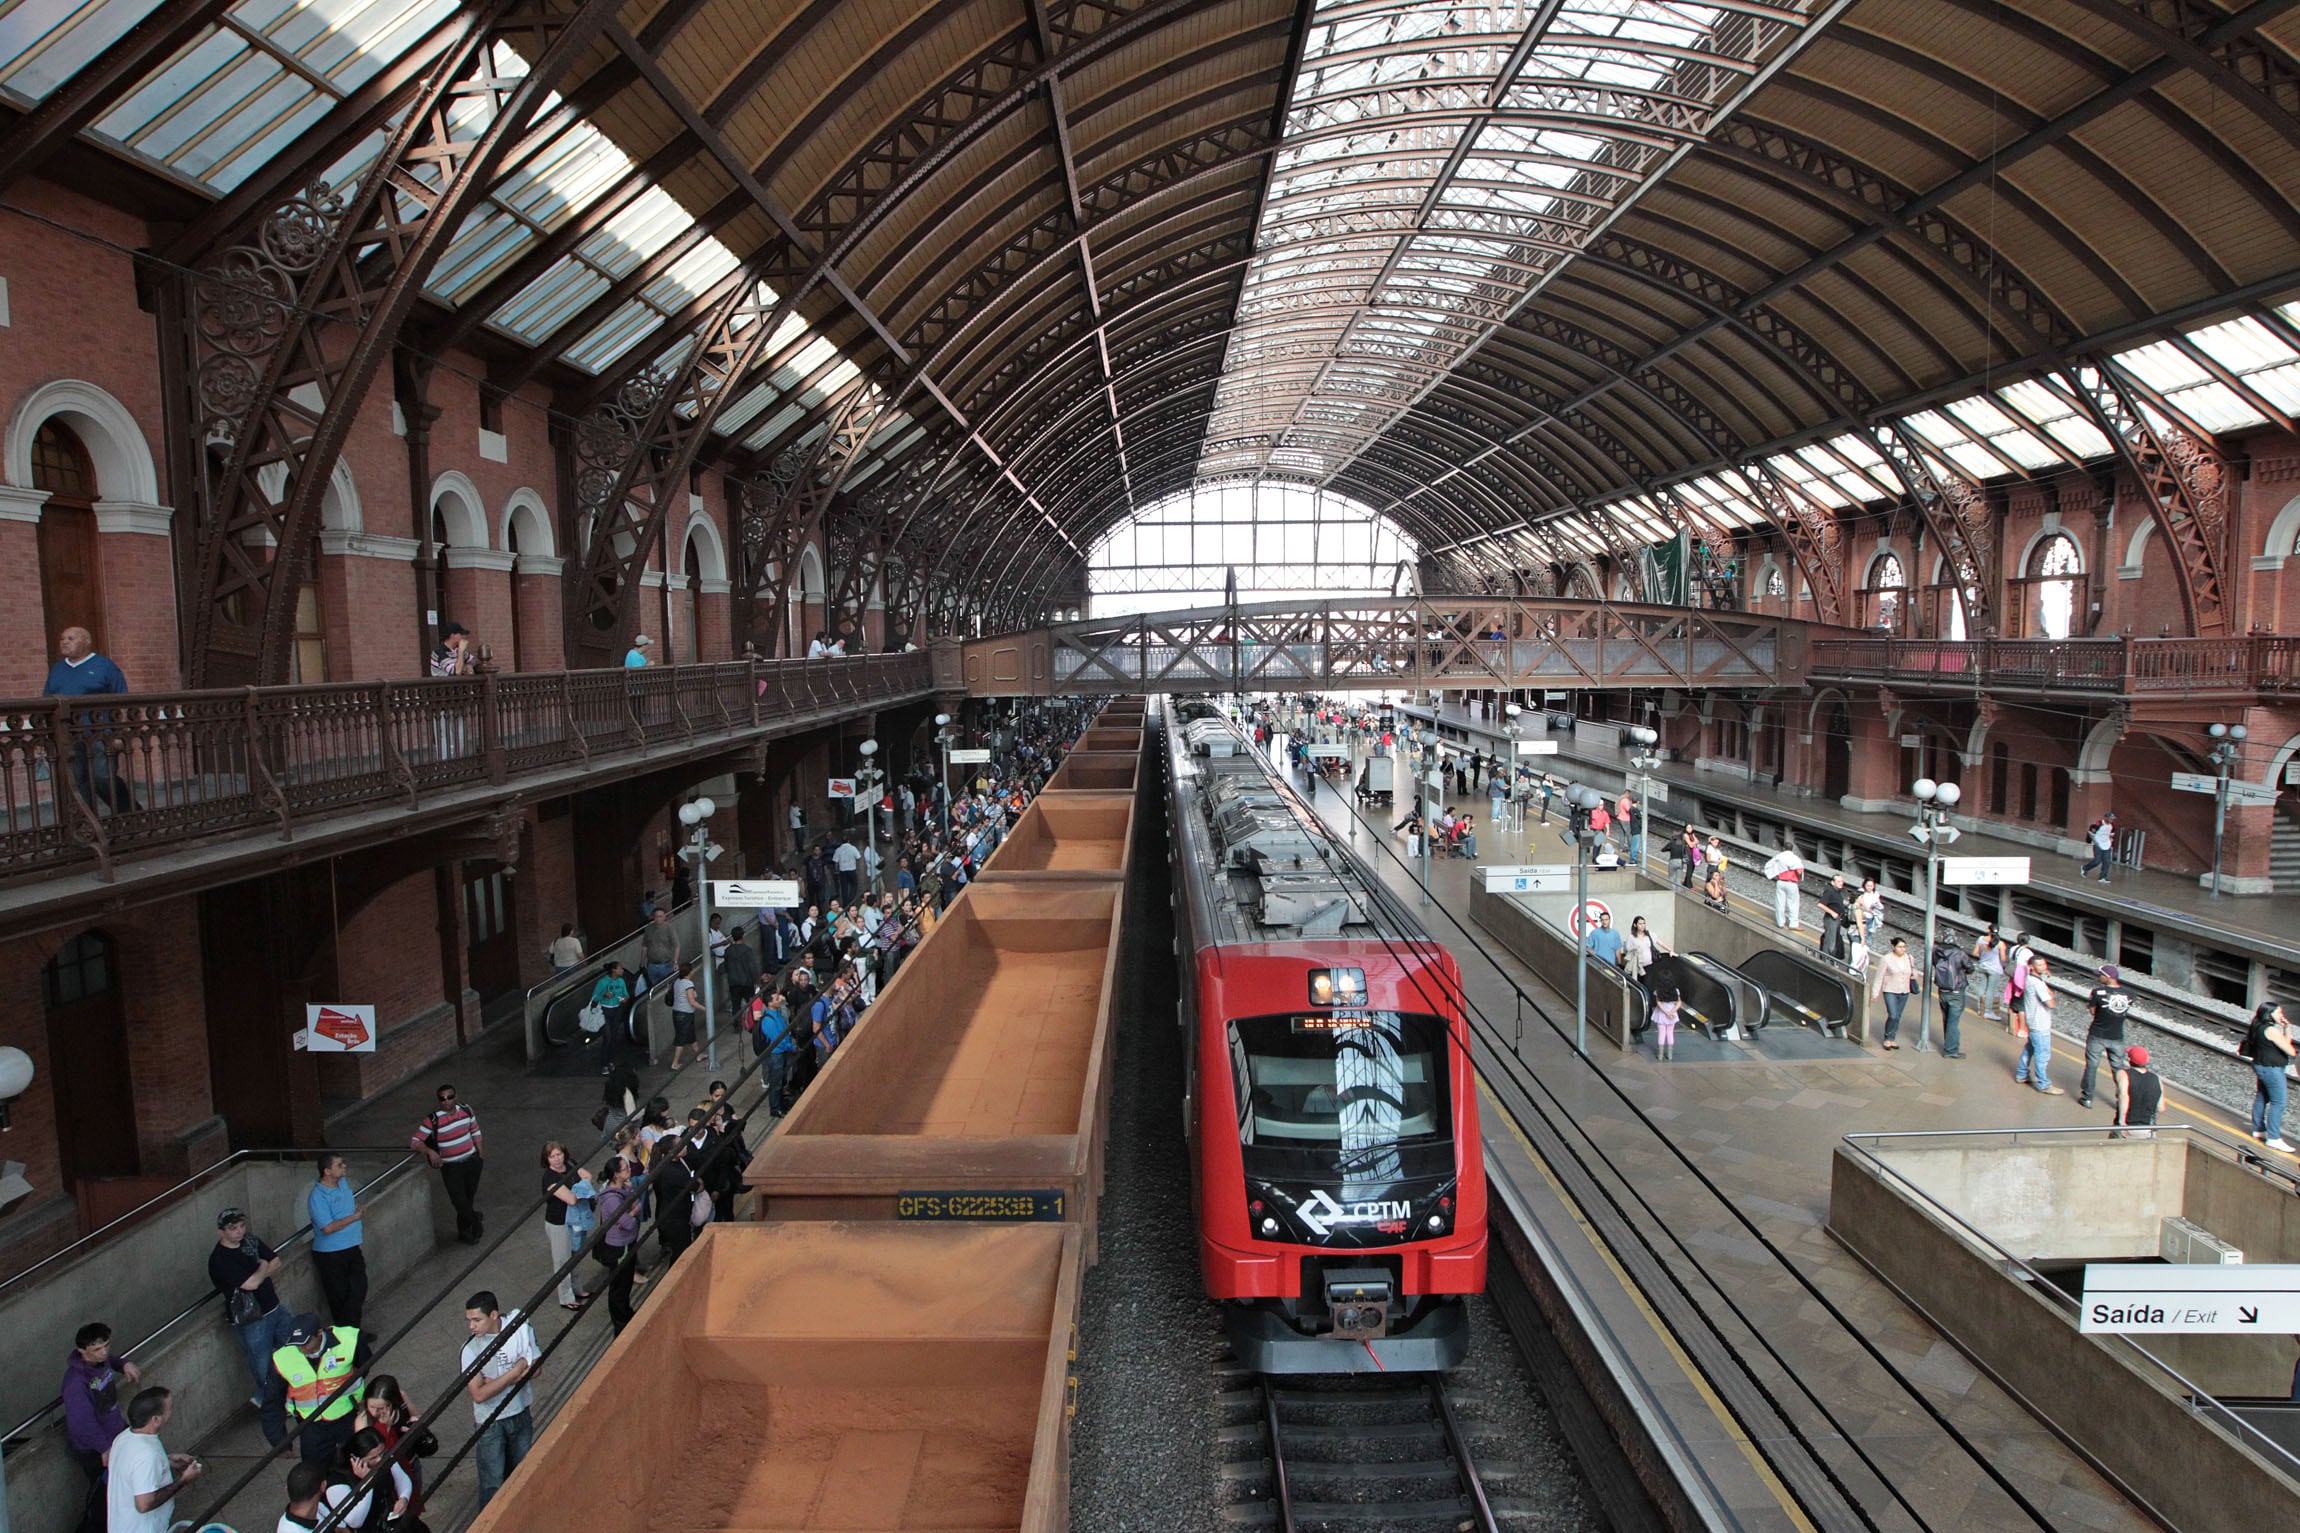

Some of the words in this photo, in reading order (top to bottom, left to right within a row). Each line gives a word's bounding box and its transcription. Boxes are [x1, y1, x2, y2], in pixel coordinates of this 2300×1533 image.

[2242, 789, 2256, 798] Luz
[1353, 1200, 1411, 1219] CPTM
[2092, 1303, 2164, 1324] Saída
[2171, 1309, 2181, 1323] /
[2184, 1309, 2218, 1323] Exit
